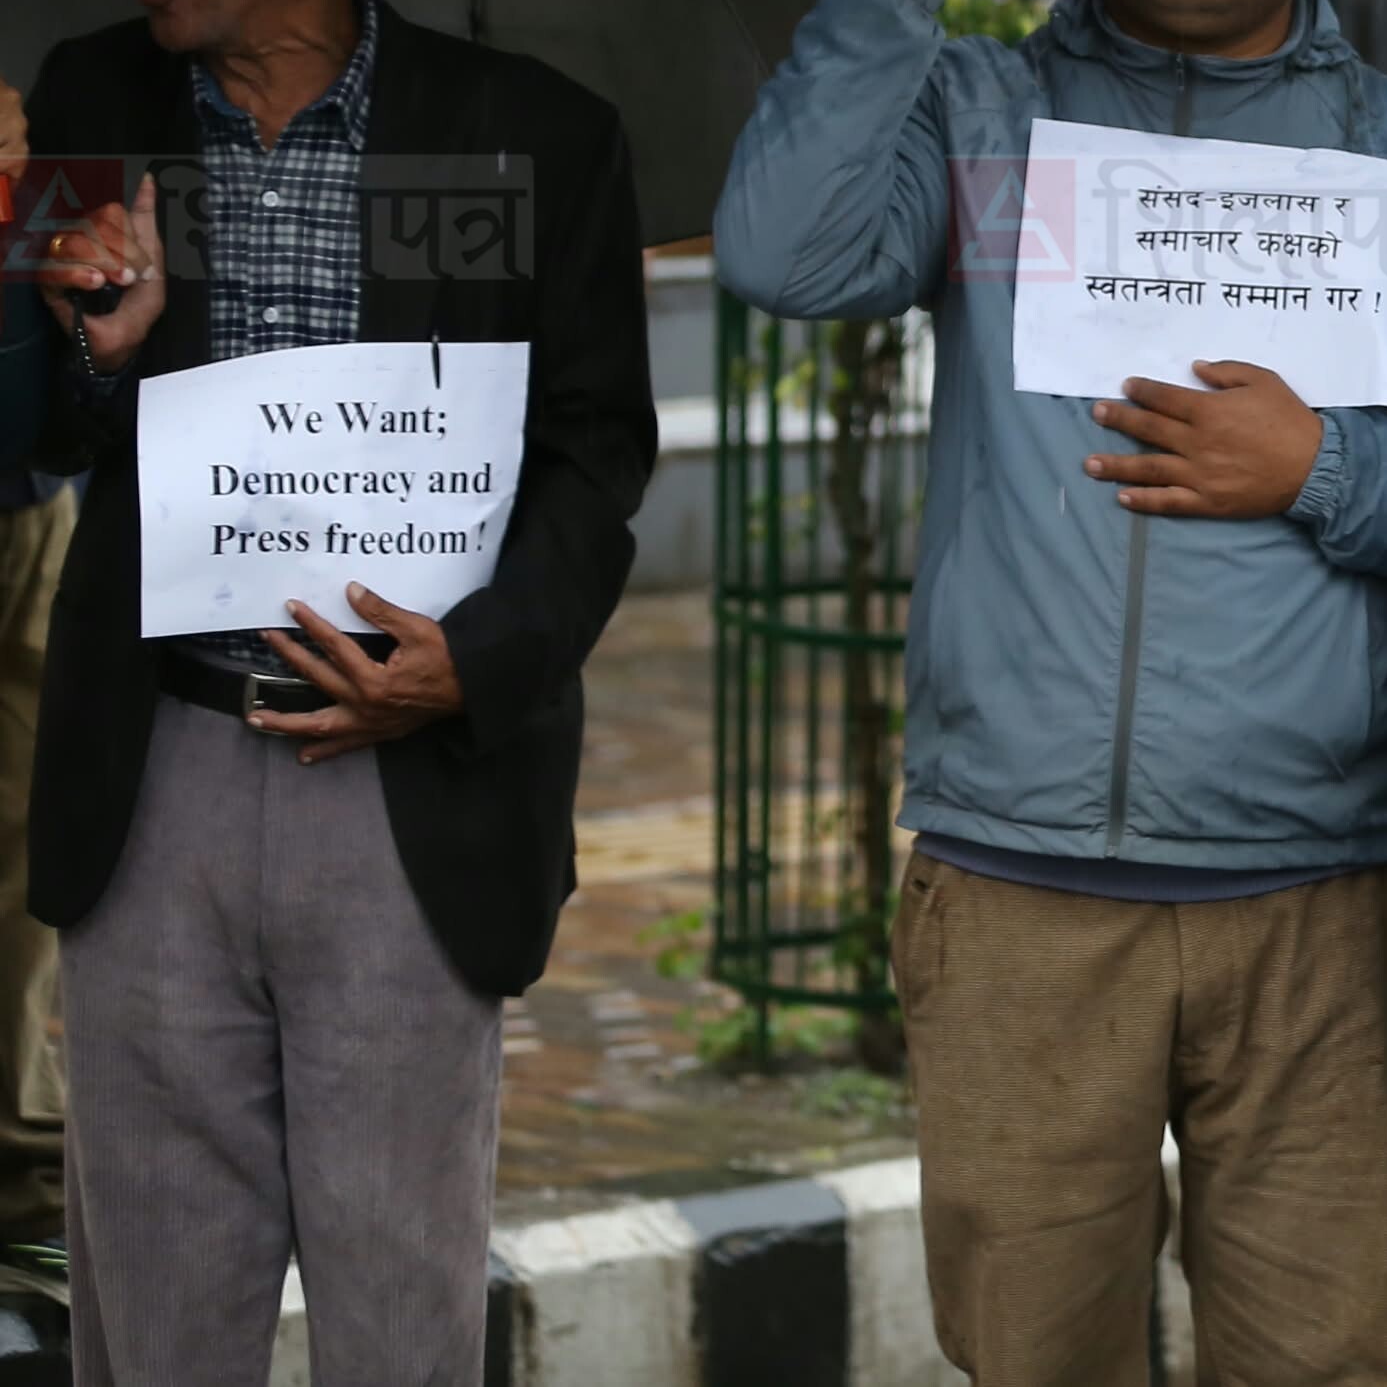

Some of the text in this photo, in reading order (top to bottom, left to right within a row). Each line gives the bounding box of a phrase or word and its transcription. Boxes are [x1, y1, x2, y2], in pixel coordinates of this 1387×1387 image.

[1333, 197, 1352, 216] र
[1135, 230, 1342, 259] समाचार कक्षको
[1084, 275, 1206, 305] स्वतन्त्रता
[1221, 283, 1311, 311] सम्मान
[1326, 287, 1363, 313] गर
[258, 402, 447, 439] We Want;
[208, 462, 493, 503] Democracy and
[210, 523, 311, 556] Press
